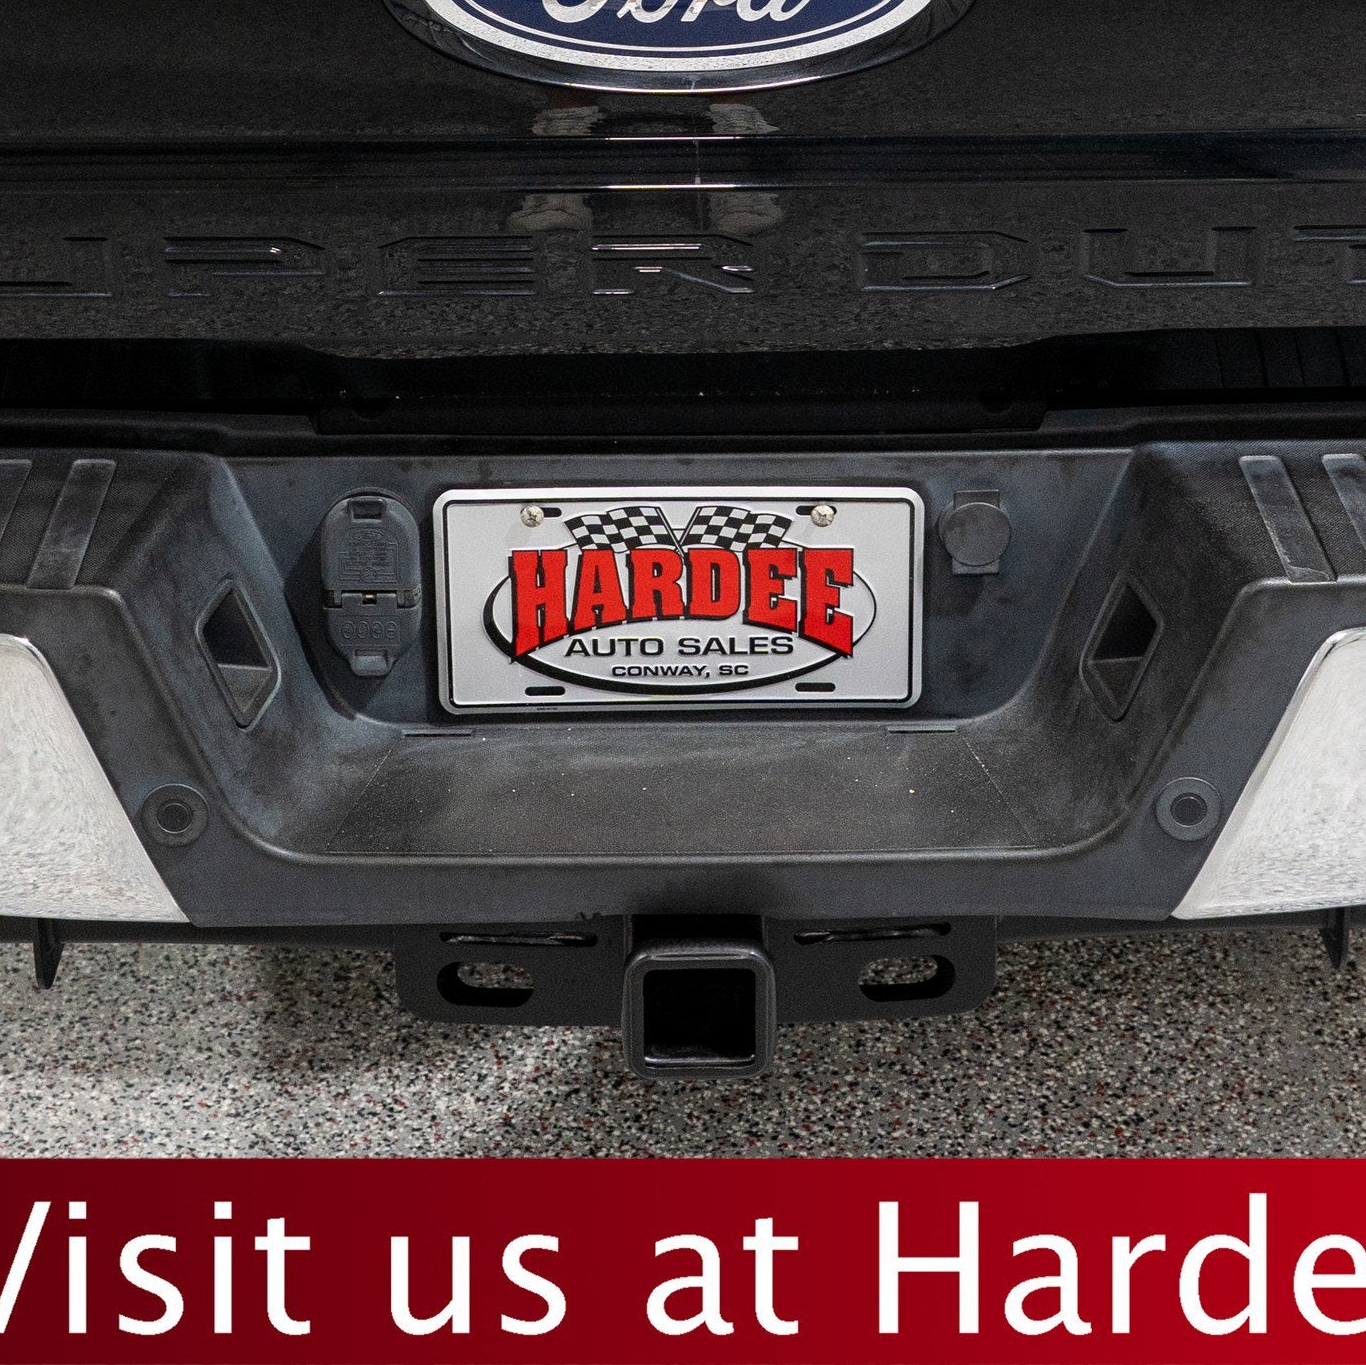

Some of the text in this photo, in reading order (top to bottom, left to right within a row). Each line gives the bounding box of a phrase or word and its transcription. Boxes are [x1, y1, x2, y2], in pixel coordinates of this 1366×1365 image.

[508, 547, 855, 663] HARDEE
[564, 635, 795, 658] AUTO SALES
[611, 663, 750, 679] CONWAY, SC
